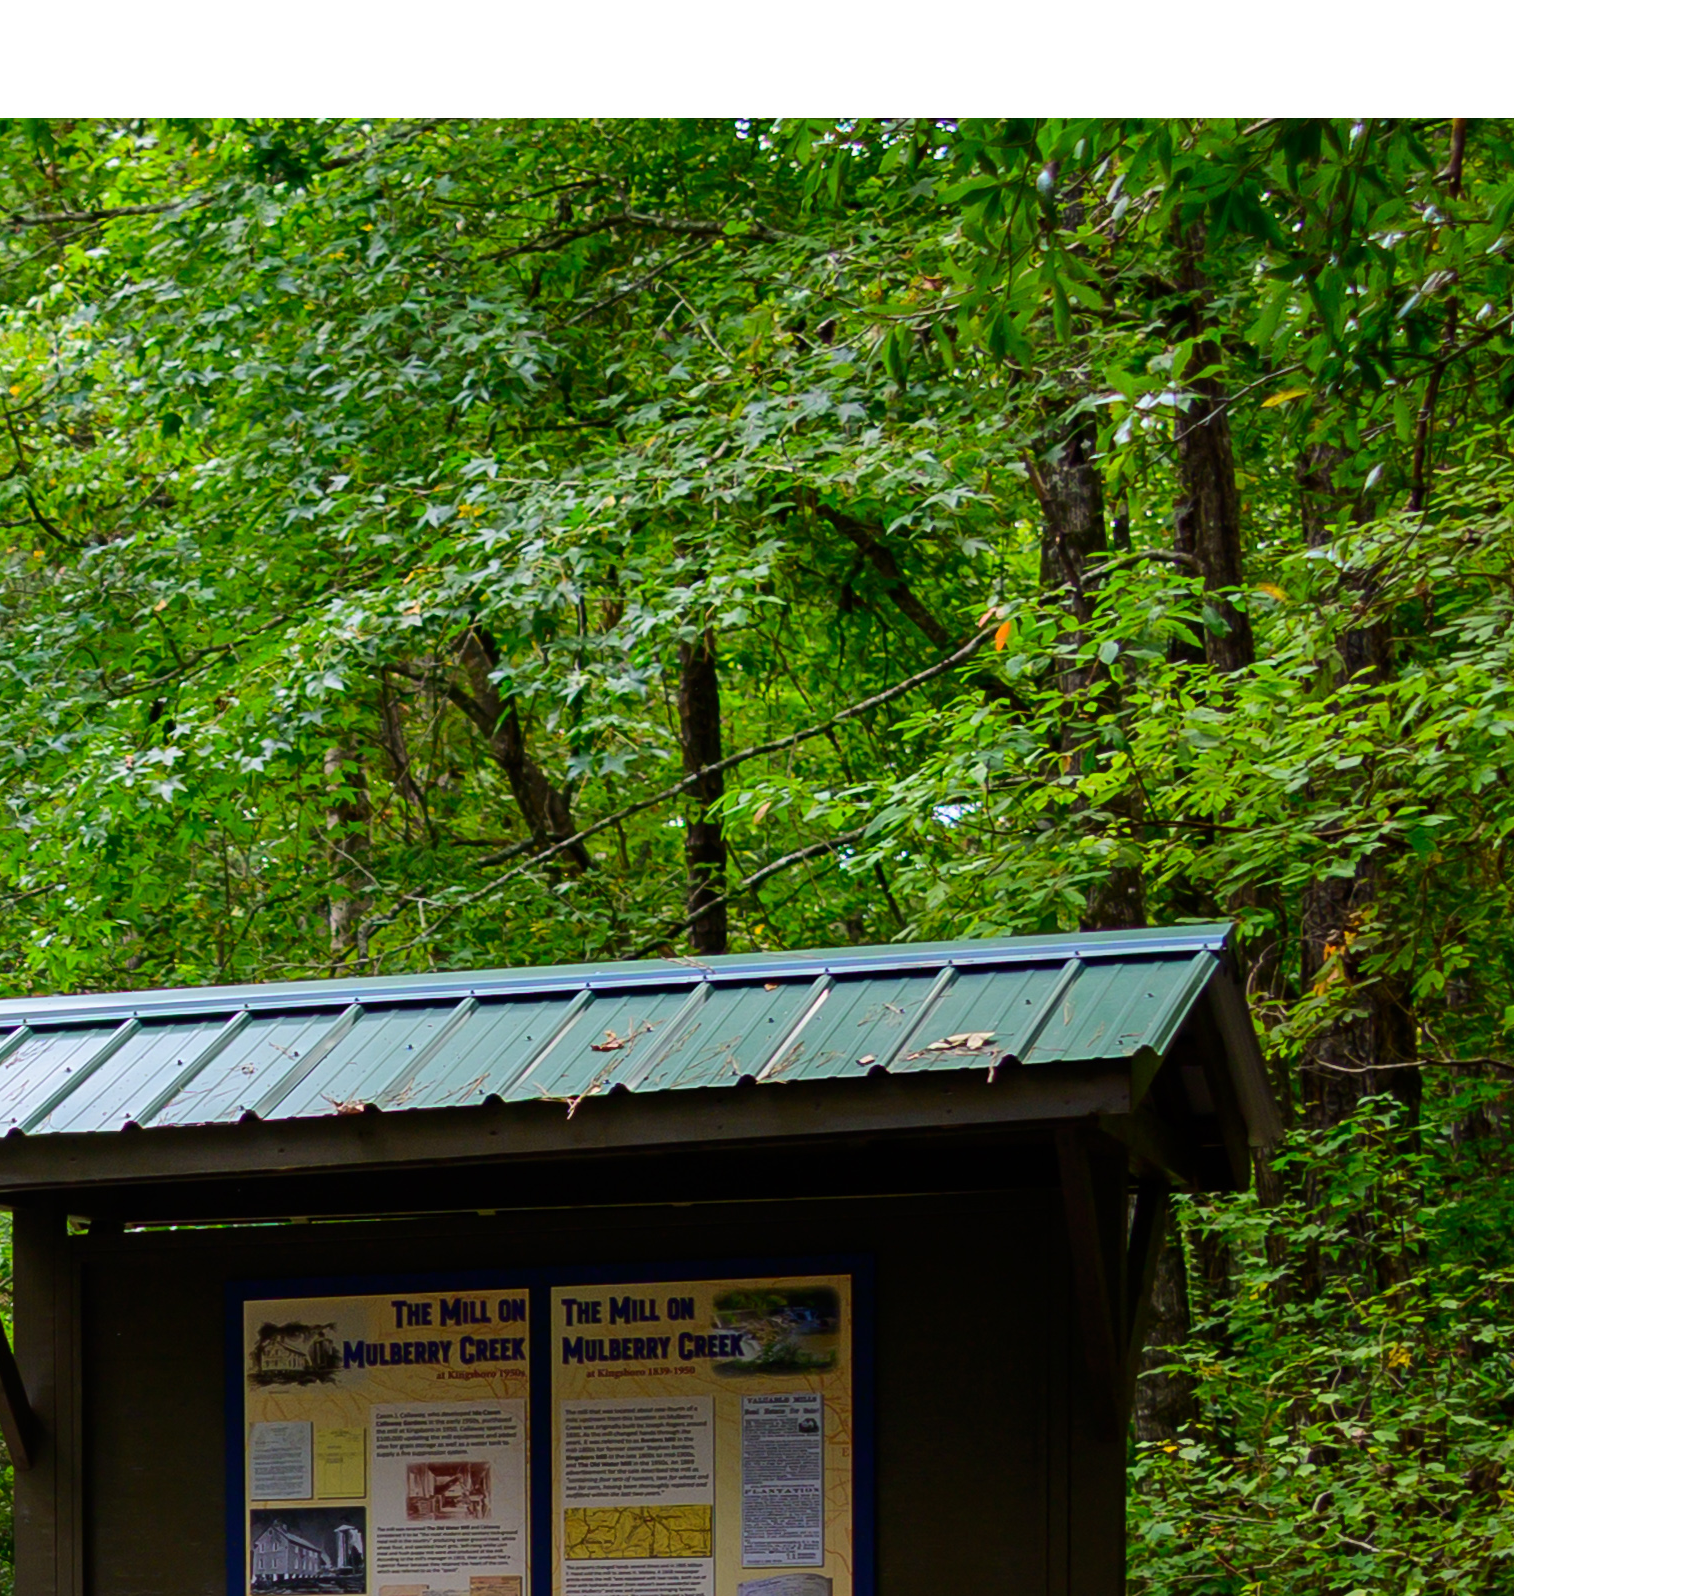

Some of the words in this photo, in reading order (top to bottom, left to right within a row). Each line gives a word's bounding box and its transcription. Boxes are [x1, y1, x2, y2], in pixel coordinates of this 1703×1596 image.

[436, 1372, 446, 1380] at
[448, 1370, 495, 1382] Kingsboro
[586, 1370, 596, 1378] at
[598, 1368, 645, 1380] Kingsboro
[649, 1366, 695, 1376] 1839-1950
